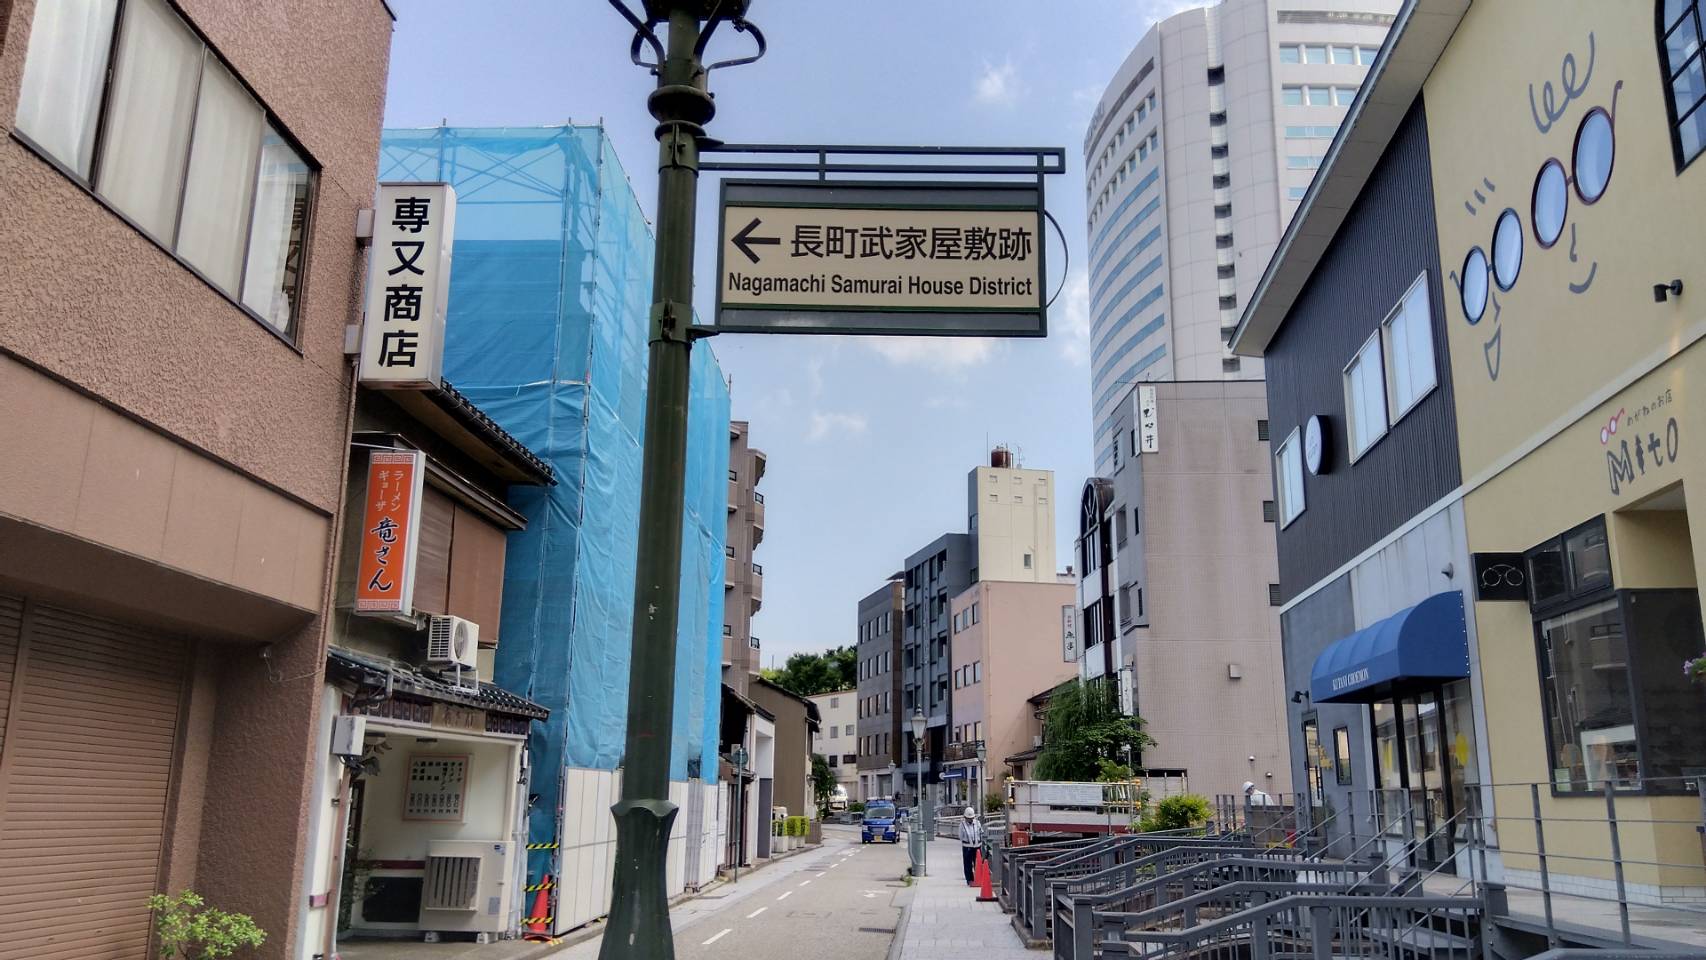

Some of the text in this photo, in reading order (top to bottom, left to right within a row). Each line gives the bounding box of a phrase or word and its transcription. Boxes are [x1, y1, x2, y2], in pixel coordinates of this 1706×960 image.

[790, 224, 1032, 262] 長町武家屋敷跡
[378, 197, 431, 369] 専又商店
[728, 272, 1032, 296] Nagamachi Samurai House District
[375, 470, 390, 512] ギョーザ
[391, 470, 404, 512] ラーメン
[369, 517, 399, 592] 竜さん
